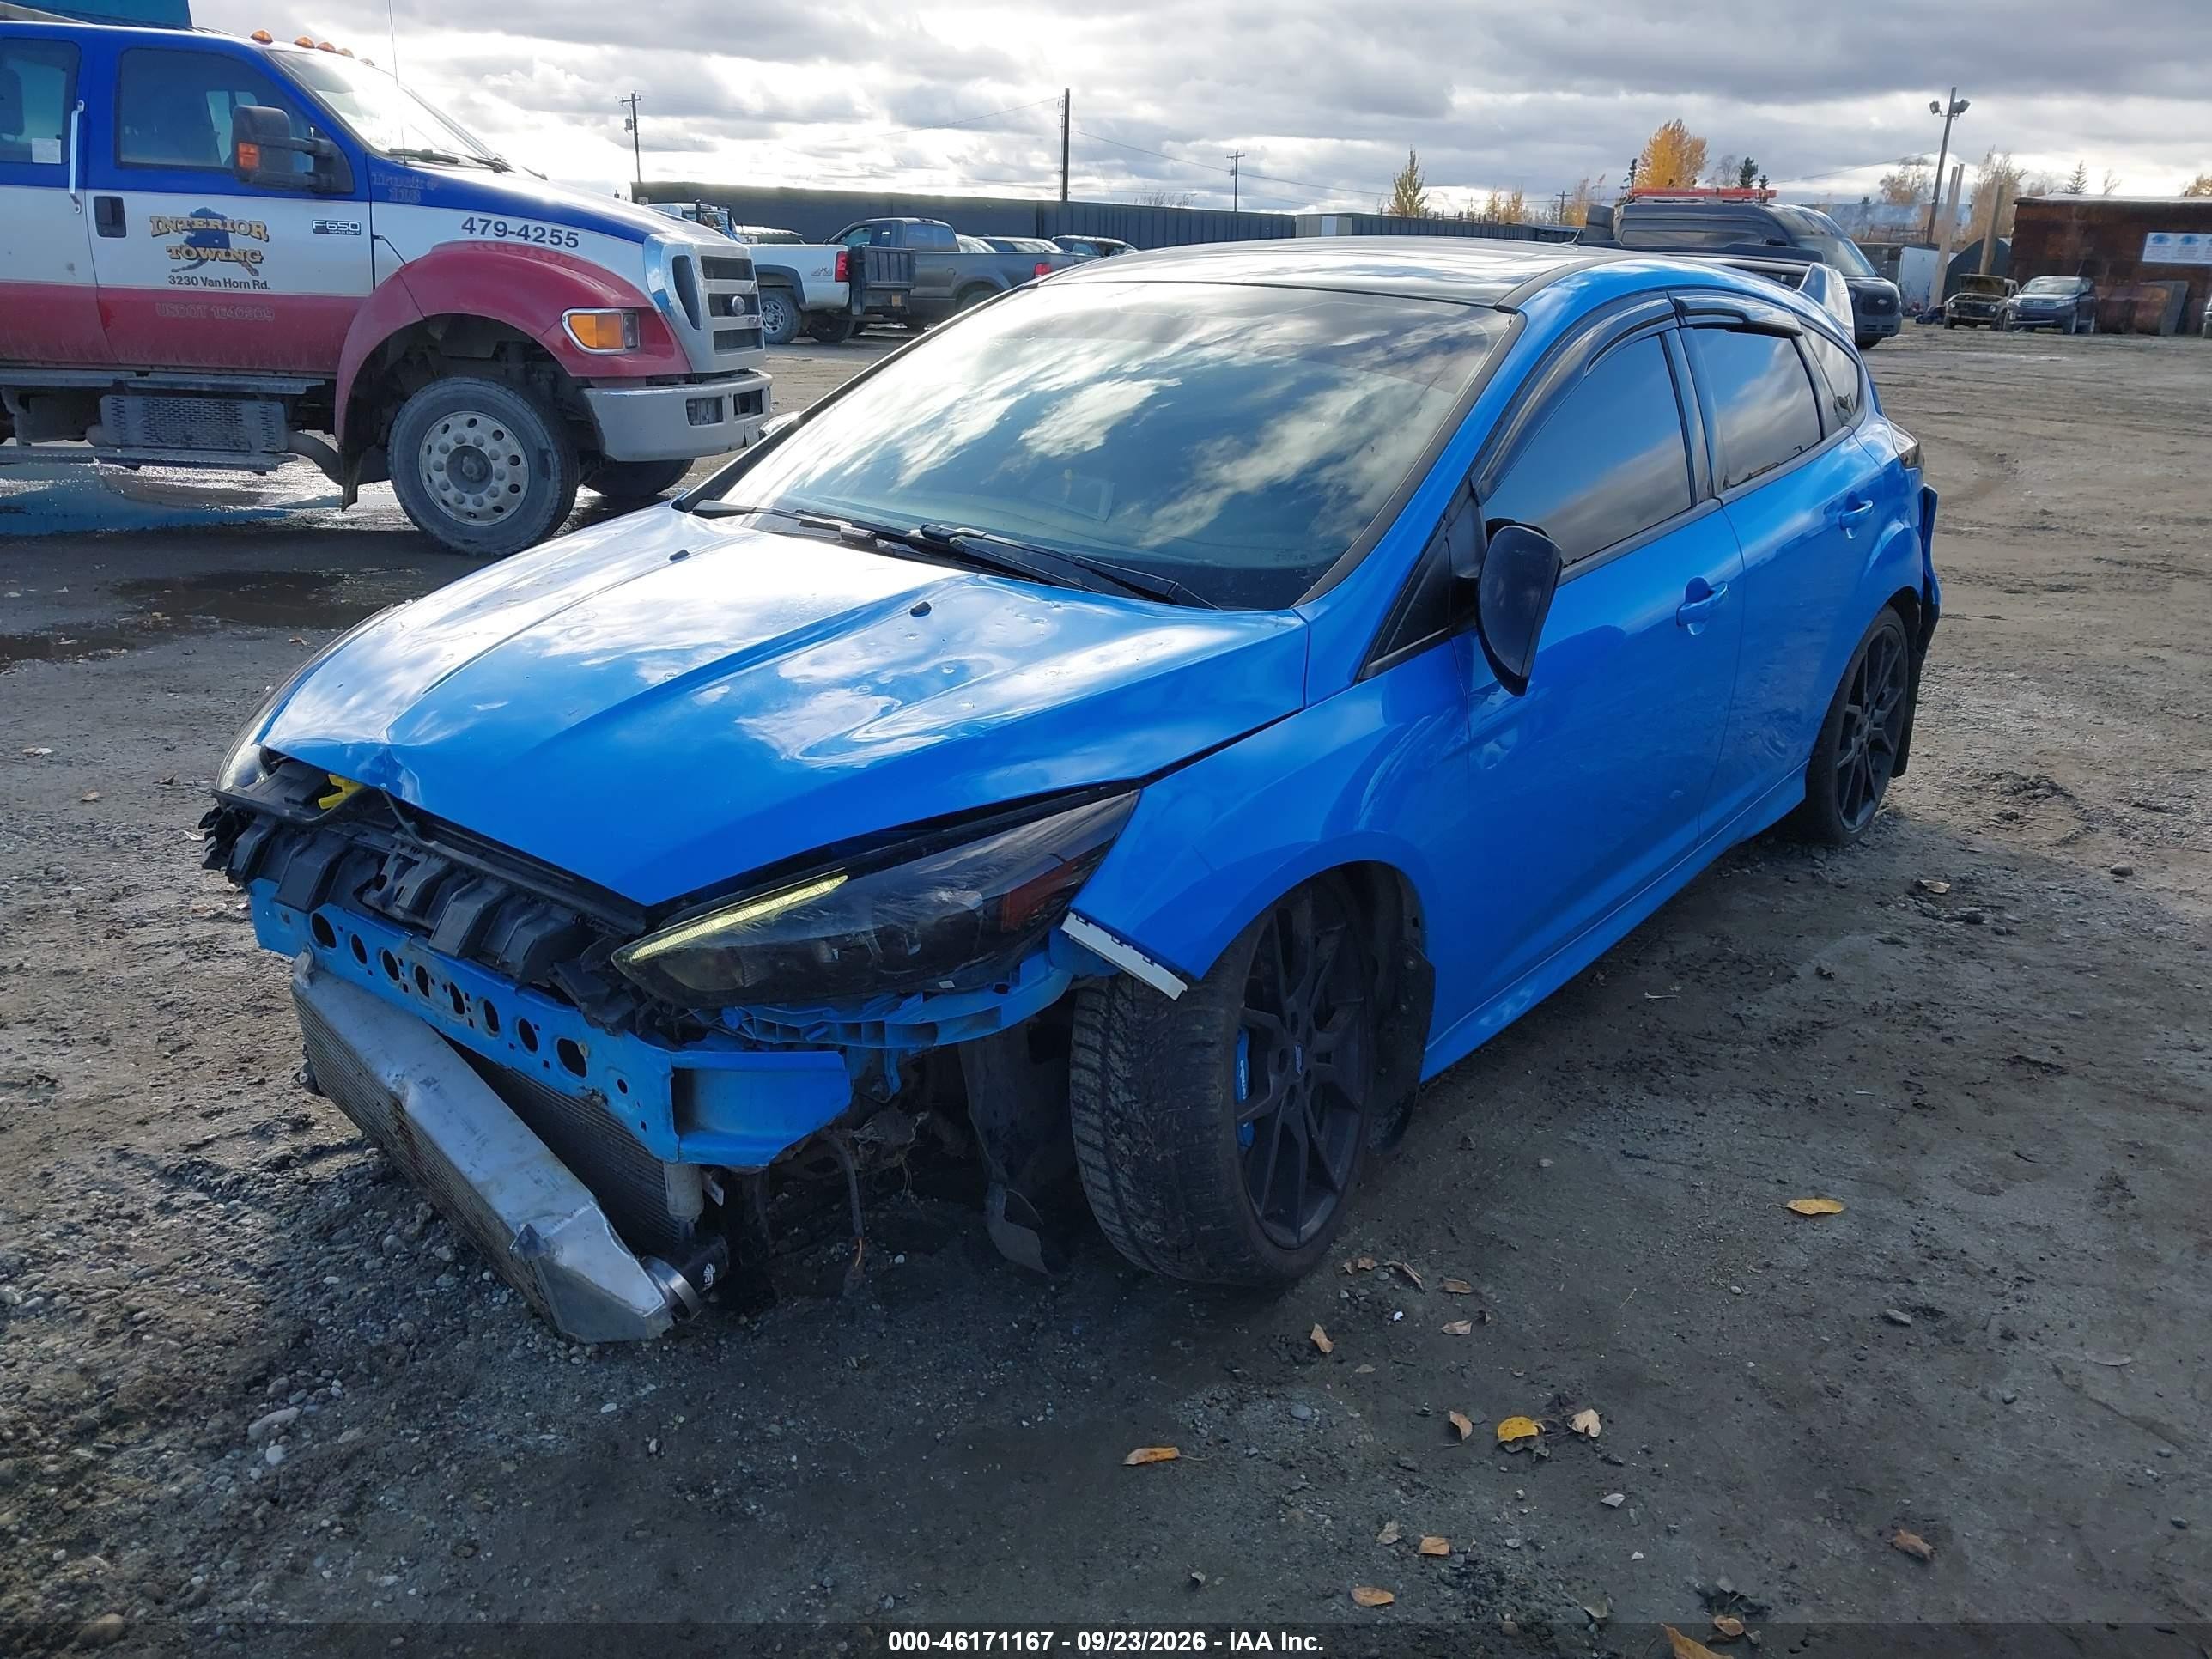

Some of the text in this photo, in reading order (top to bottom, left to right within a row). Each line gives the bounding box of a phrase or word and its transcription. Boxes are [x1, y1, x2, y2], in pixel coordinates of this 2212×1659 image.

[149, 216, 270, 242] INTERIOR
[461, 216, 579, 248] 479-4255
[166, 245, 264, 264] TOWING
[168, 275, 270, 290] 3230 Van Horn Rd.
